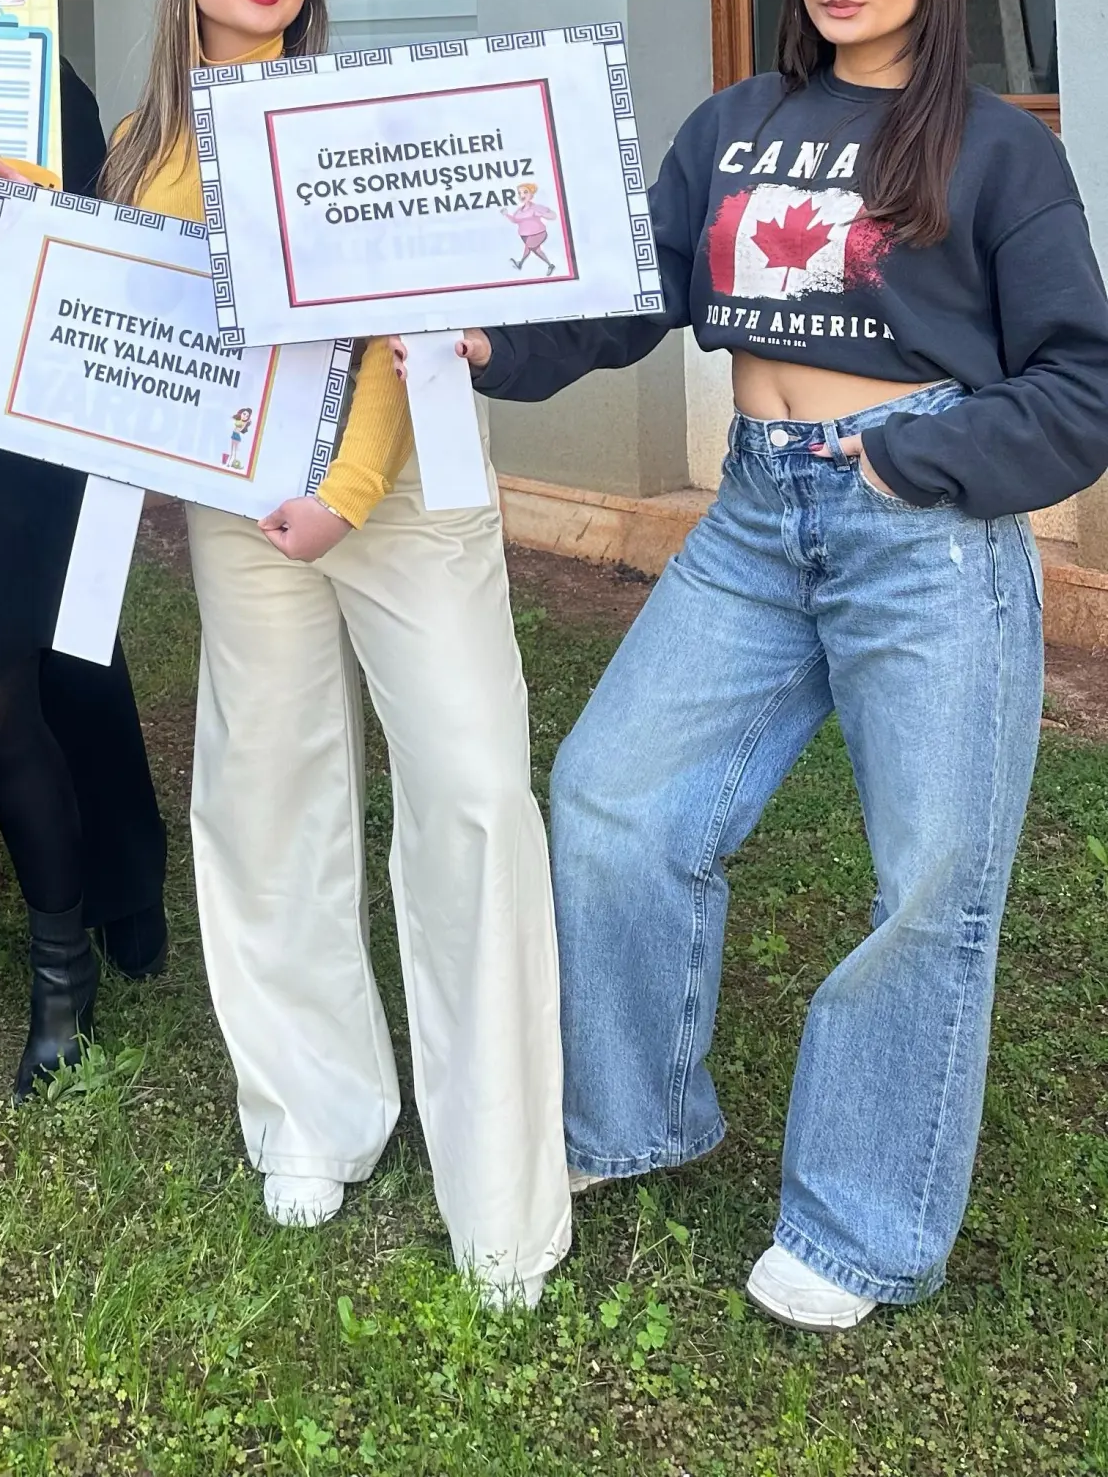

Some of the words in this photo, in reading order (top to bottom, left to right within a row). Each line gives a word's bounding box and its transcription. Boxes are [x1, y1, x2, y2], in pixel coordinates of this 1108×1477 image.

[317, 128, 504, 170] ÜZERİMDEKİLERİ
[296, 178, 348, 206] ÇOK
[353, 158, 535, 195] SORMUŞSUNUZ
[325, 201, 394, 224] ÖDEM
[399, 198, 429, 218] VE
[435, 188, 518, 214] NAZAR
[58, 298, 174, 343] DİYETTEYİM
[783, 339, 792, 347] TO
[49, 325, 110, 354] ARTIK
[113, 339, 242, 389] YALANLARINI
[82, 360, 202, 407] YEMİYORUM
